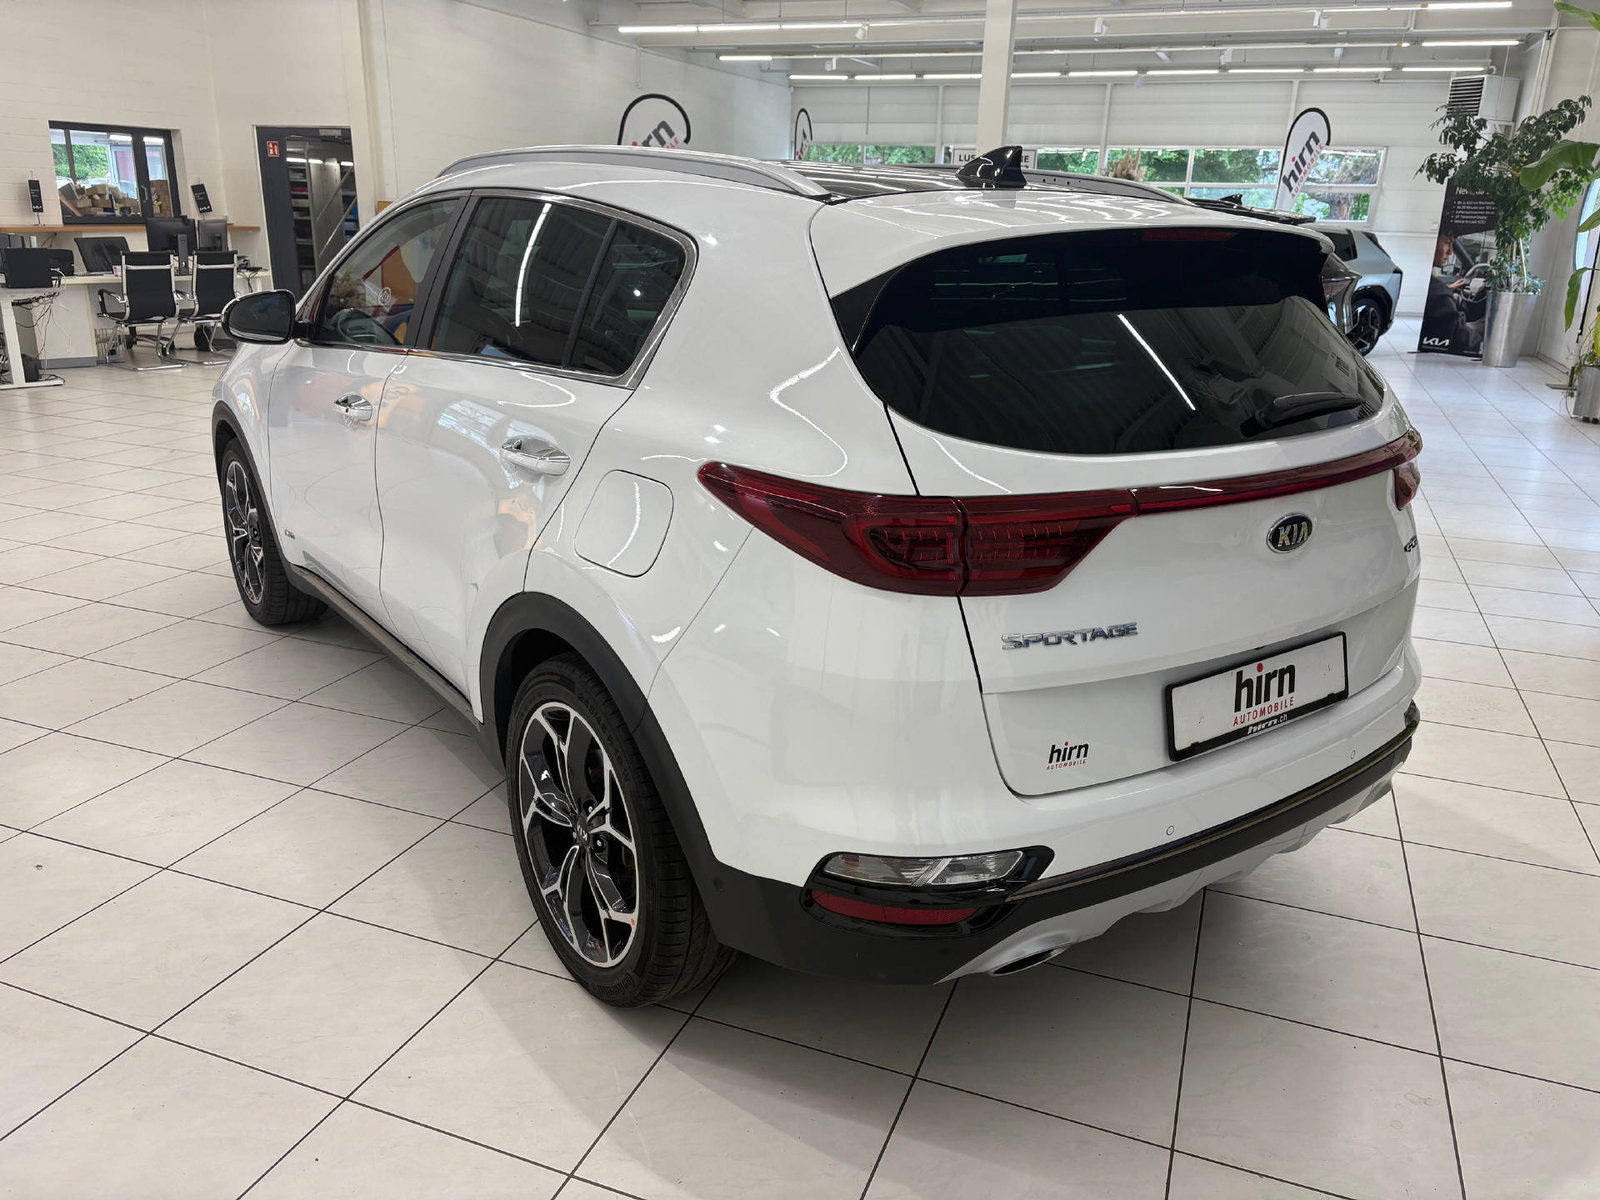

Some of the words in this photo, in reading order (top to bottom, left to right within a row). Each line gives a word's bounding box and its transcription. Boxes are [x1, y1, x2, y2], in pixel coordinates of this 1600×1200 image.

[1282, 131, 1320, 188] hirn
[1277, 521, 1309, 547] KIA
[1000, 621, 1139, 651] SPORTAGE
[1234, 662, 1296, 713] hirn
[1233, 696, 1294, 727] AUTOMOBILE
[1247, 713, 1288, 735] hirn.ch
[1048, 741, 1089, 764] hirn
